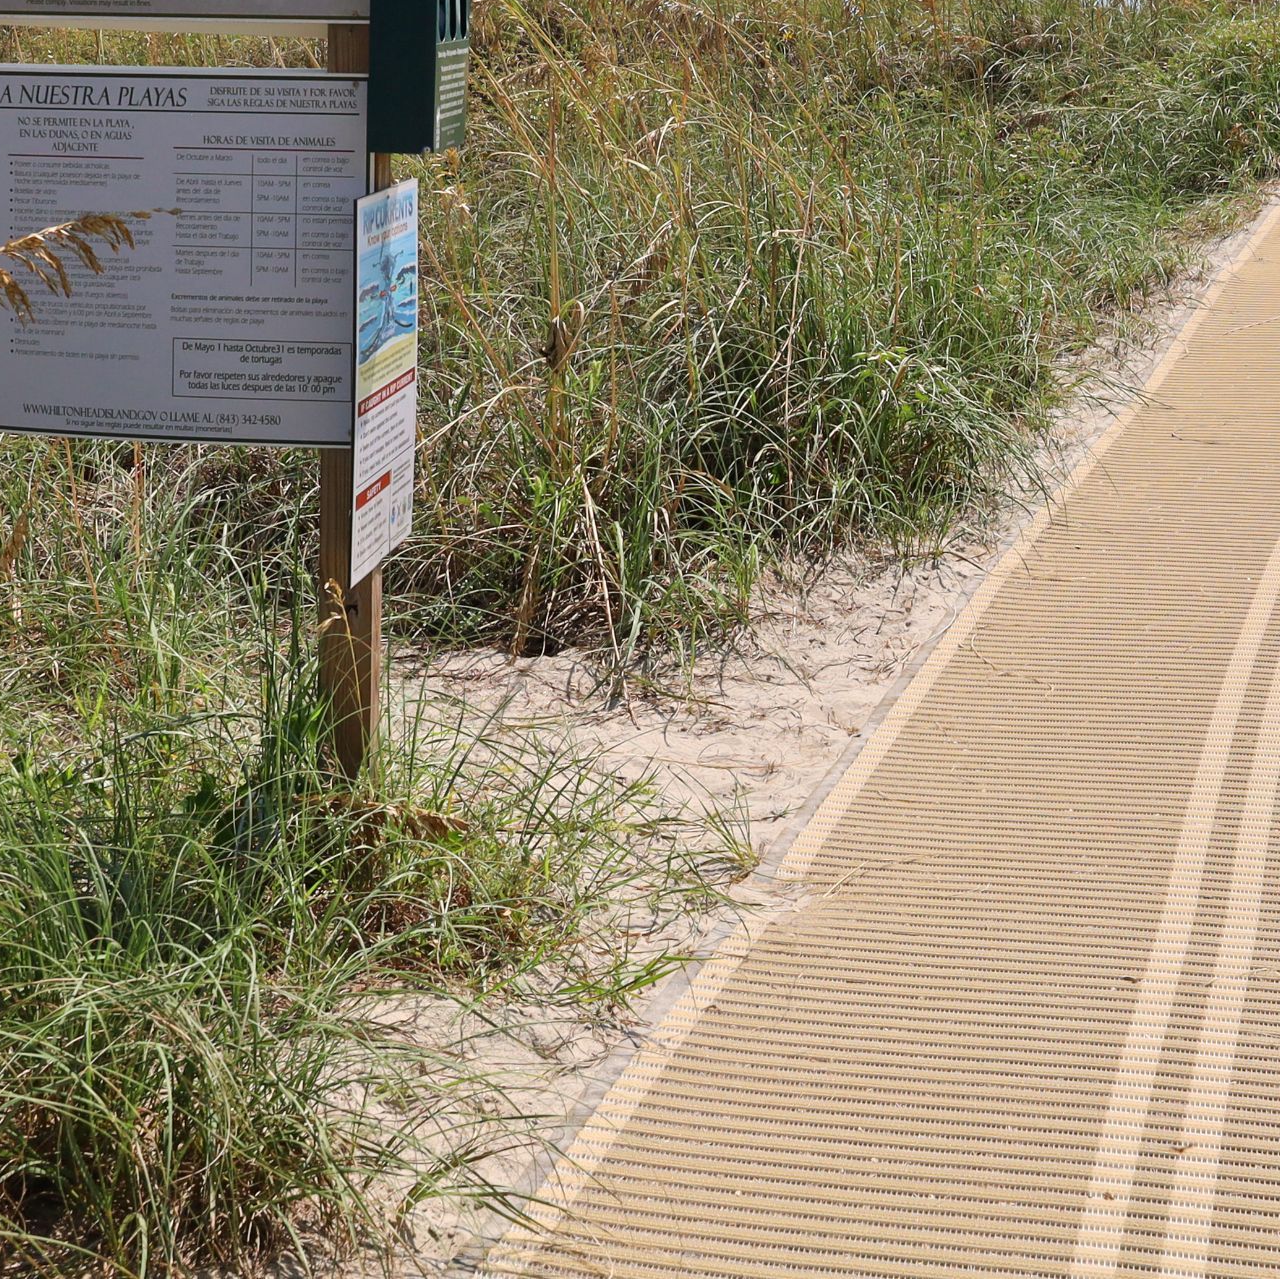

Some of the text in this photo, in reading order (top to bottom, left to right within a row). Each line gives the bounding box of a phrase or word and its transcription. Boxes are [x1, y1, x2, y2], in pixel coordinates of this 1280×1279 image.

[0, 86, 13, 103] A
[20, 85, 112, 105] NUESTRA
[118, 87, 187, 107] PLAYAS
[210, 87, 247, 95] DISFRUTE
[250, 87, 262, 96] DE
[265, 87, 275, 96] SU
[277, 88, 300, 96] VISITA
[303, 88, 308, 96] Y
[329, 88, 356, 97] FAVOR
[207, 98, 357, 109] SIGA LAS REGLAS DE NUESTRA PLAYAS
[18, 117, 130, 128] NO SE PERMITE EN LA PLAYA
[19, 129, 132, 140] EN LAS DUNAS, O EN AGUAS
[203, 135, 336, 146] HORAS DE VISITA DE ANIMALES
[52, 142, 99, 153] ADJACENTE
[363, 202, 413, 235] RIP CURRENTS
[368, 234, 379, 246] Know
[392, 222, 408, 236] options
[182, 341, 193, 350] De
[195, 342, 215, 353] Mayo
[218, 343, 221, 351] 1
[223, 343, 243, 352] hasta
[296, 345, 342, 356] temporadas
[240, 355, 282, 366] de tortugas
[180, 370, 192, 378] Por
[194, 371, 212, 379] favor
[214, 372, 246, 381] respeten
[261, 373, 305, 382] alrededores
[306, 376, 311, 384] y
[313, 376, 343, 385] apague
[188, 381, 208, 390] todas
[210, 382, 220, 390] las
[221, 382, 240, 391] luces
[242, 383, 272, 393] despues
[274, 384, 284, 392] de
[285, 384, 295, 392] las
[310, 385, 321, 393] 00
[160, 412, 168, 421] O
[170, 412, 200, 422] LLAME
[202, 413, 214, 423] AL
[216, 414, 239, 426] (843)
[241, 414, 281, 426] 342-4580
[367, 481, 381, 500] SAFETY
